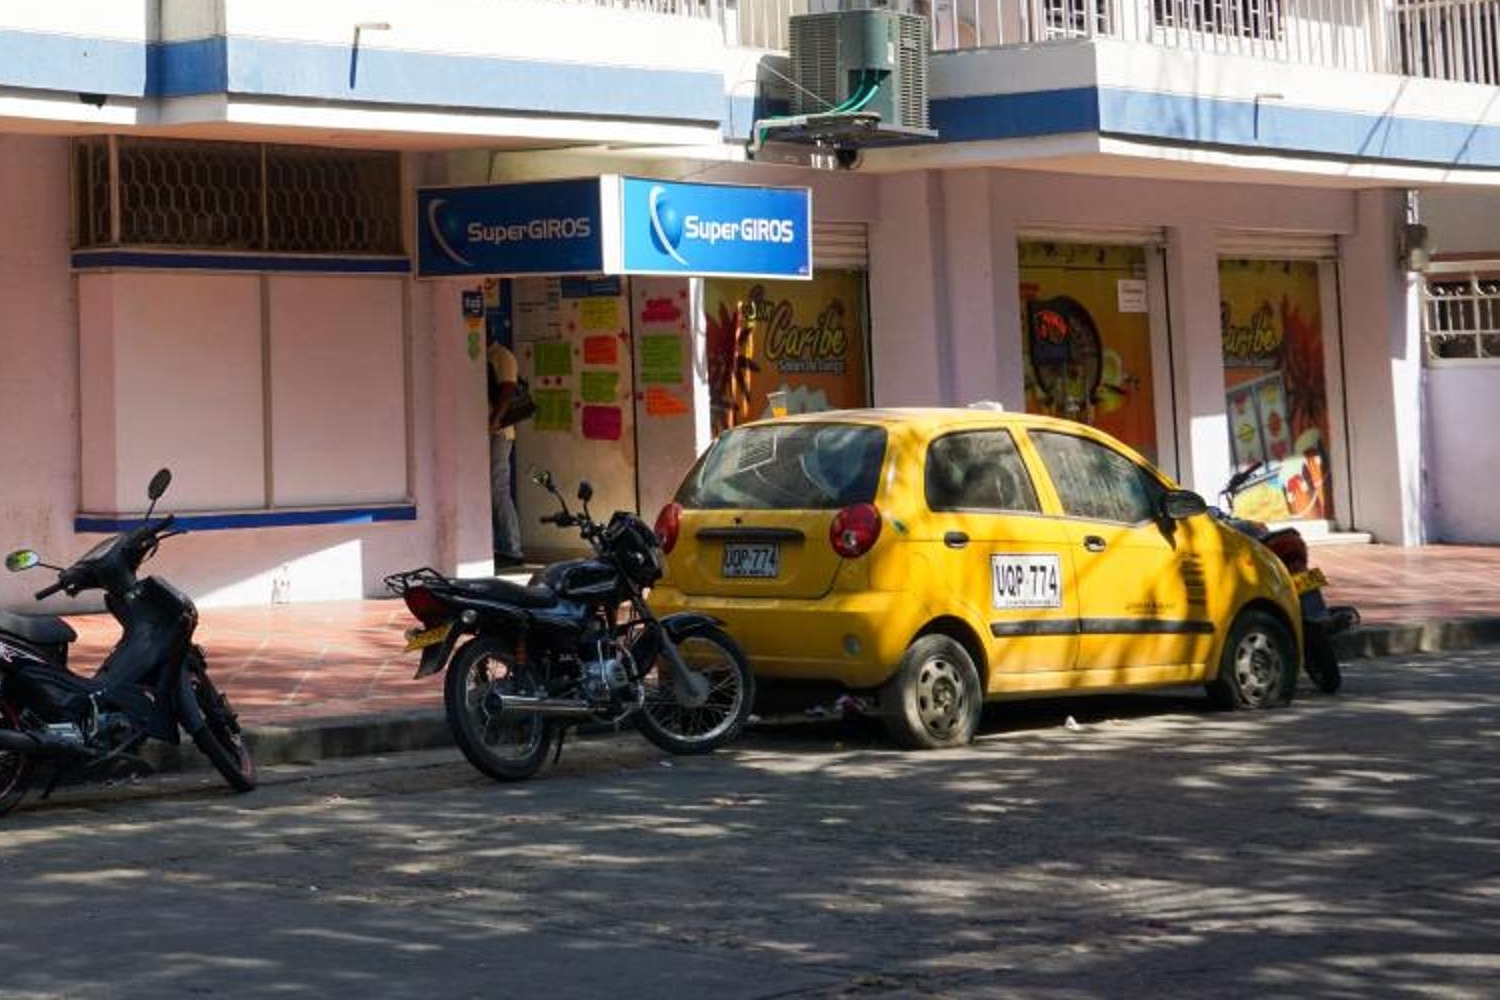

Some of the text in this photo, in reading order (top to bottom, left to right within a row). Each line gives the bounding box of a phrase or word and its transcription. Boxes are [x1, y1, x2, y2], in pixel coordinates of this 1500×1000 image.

[466, 217, 591, 243] SuperGIROS
[684, 214, 794, 243] SuperGIROS
[764, 300, 846, 361] Caribe
